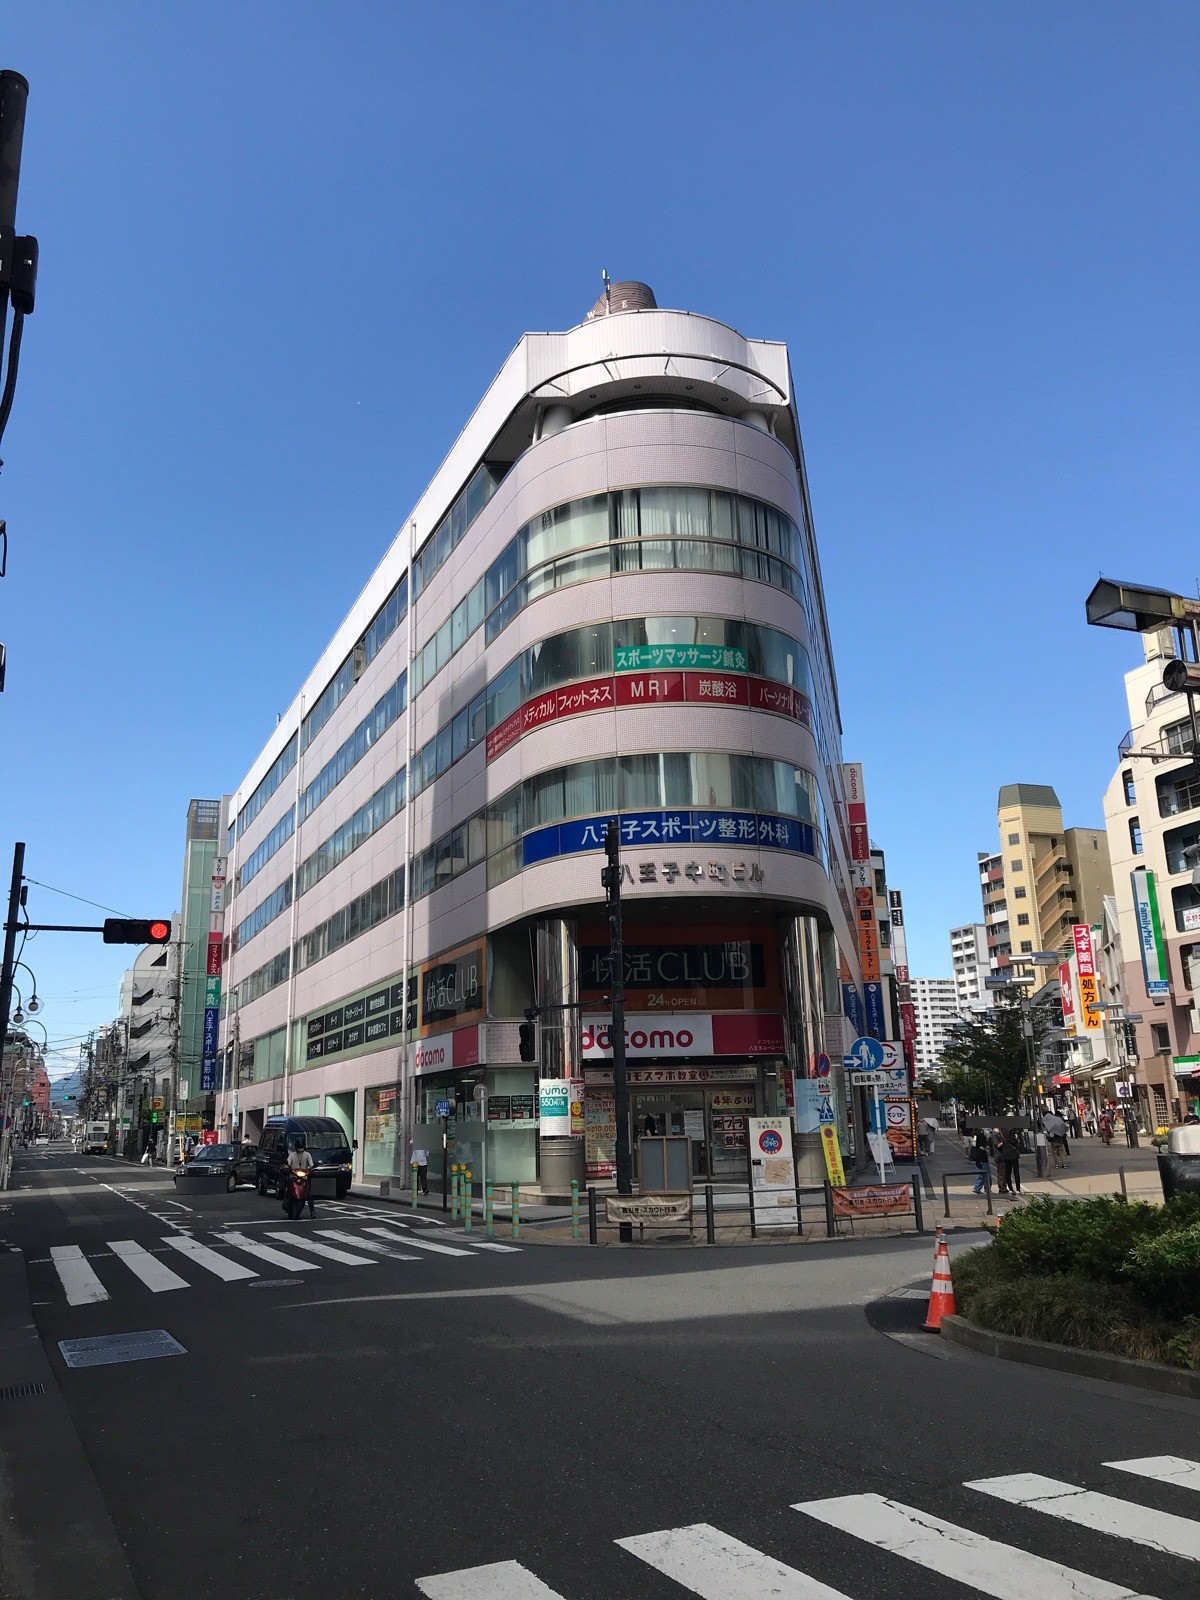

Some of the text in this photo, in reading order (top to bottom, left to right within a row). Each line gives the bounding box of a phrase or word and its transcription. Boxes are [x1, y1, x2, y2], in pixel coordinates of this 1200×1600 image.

[616, 648, 746, 669] スポーツマッサージ鍼灸
[630, 680, 668, 698] MRI
[699, 679, 737, 698] 炭酸浴
[523, 686, 612, 726] メディカル フィットネス
[849, 768, 858, 800] docomo
[619, 860, 765, 886] 八王子中町ビル
[1139, 901, 1154, 951] FamilyMart
[1073, 926, 1094, 974] スギ薬局
[426, 965, 478, 1012] 快活CLUB
[415, 1046, 445, 1068] docomo
[624, 1070, 699, 1082] コモスマホ教室
[854, 1074, 886, 1084] 自転車を除く
